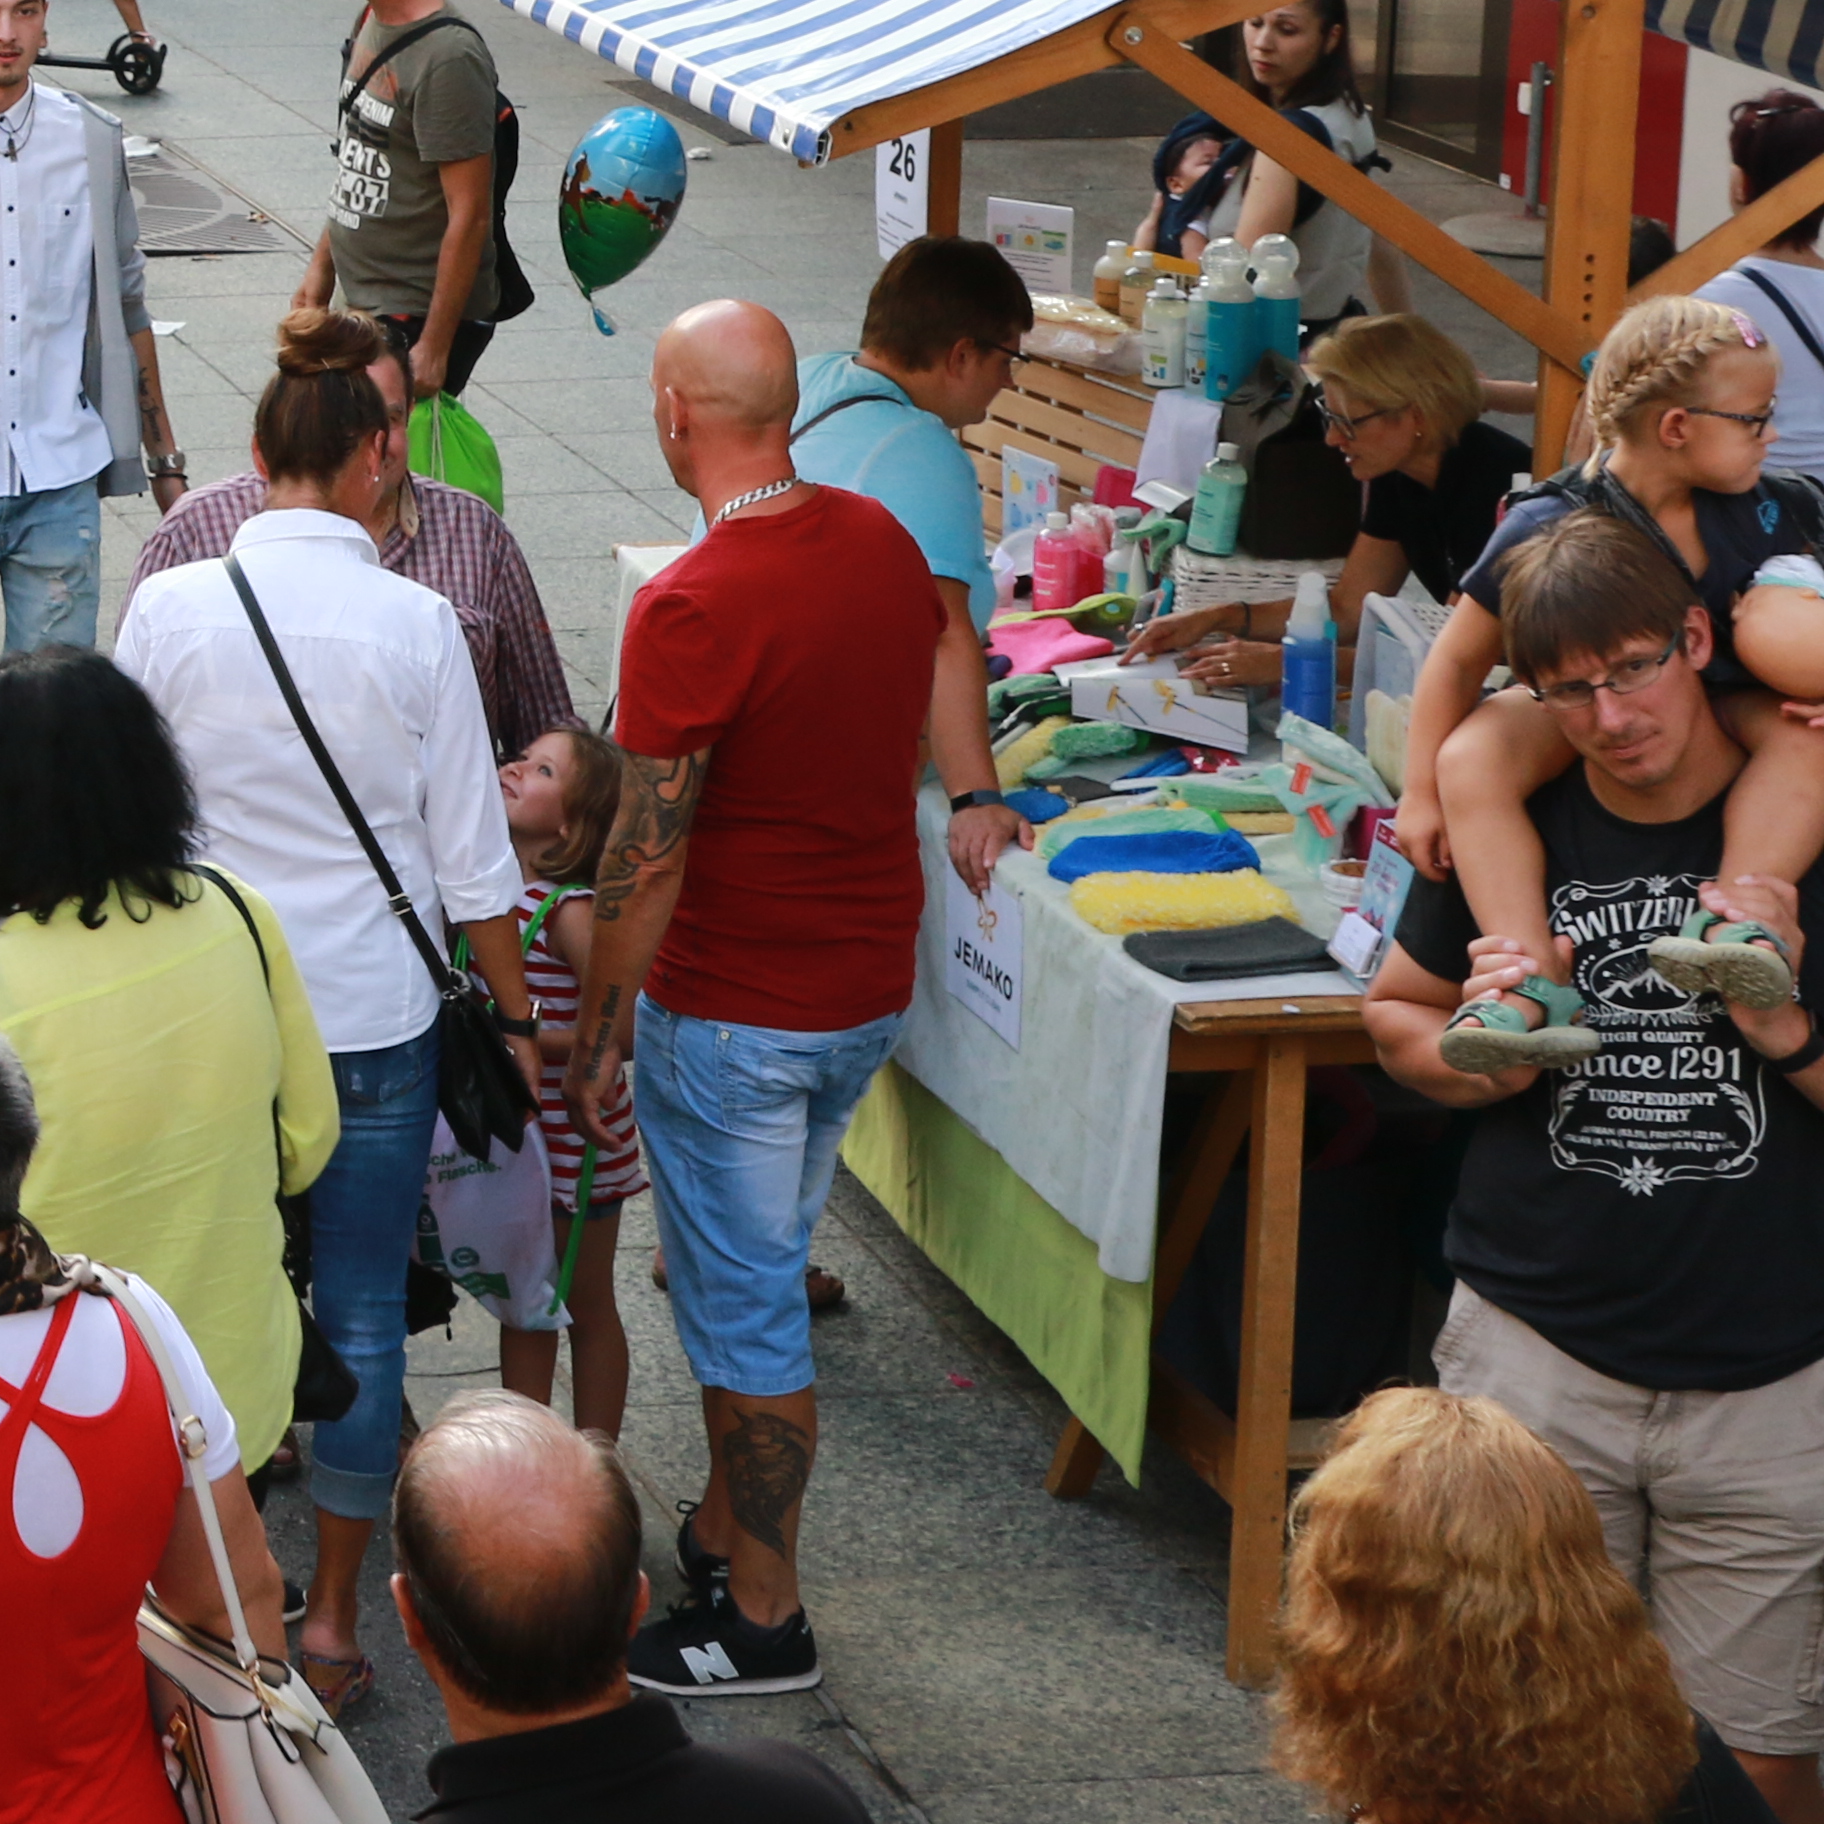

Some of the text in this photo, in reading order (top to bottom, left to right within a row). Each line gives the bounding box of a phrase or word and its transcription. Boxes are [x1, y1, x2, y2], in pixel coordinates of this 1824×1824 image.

[889, 137, 916, 183] 26
[1555, 896, 1698, 946] SWITZERL
[954, 936, 1013, 1001] JEMAKO
[1641, 1030, 1706, 1044] QUALITY
[1588, 1086, 1719, 1107] INDEPENDENT
[1606, 1105, 1692, 1123] COUNTRY
[679, 1641, 740, 1686] N
